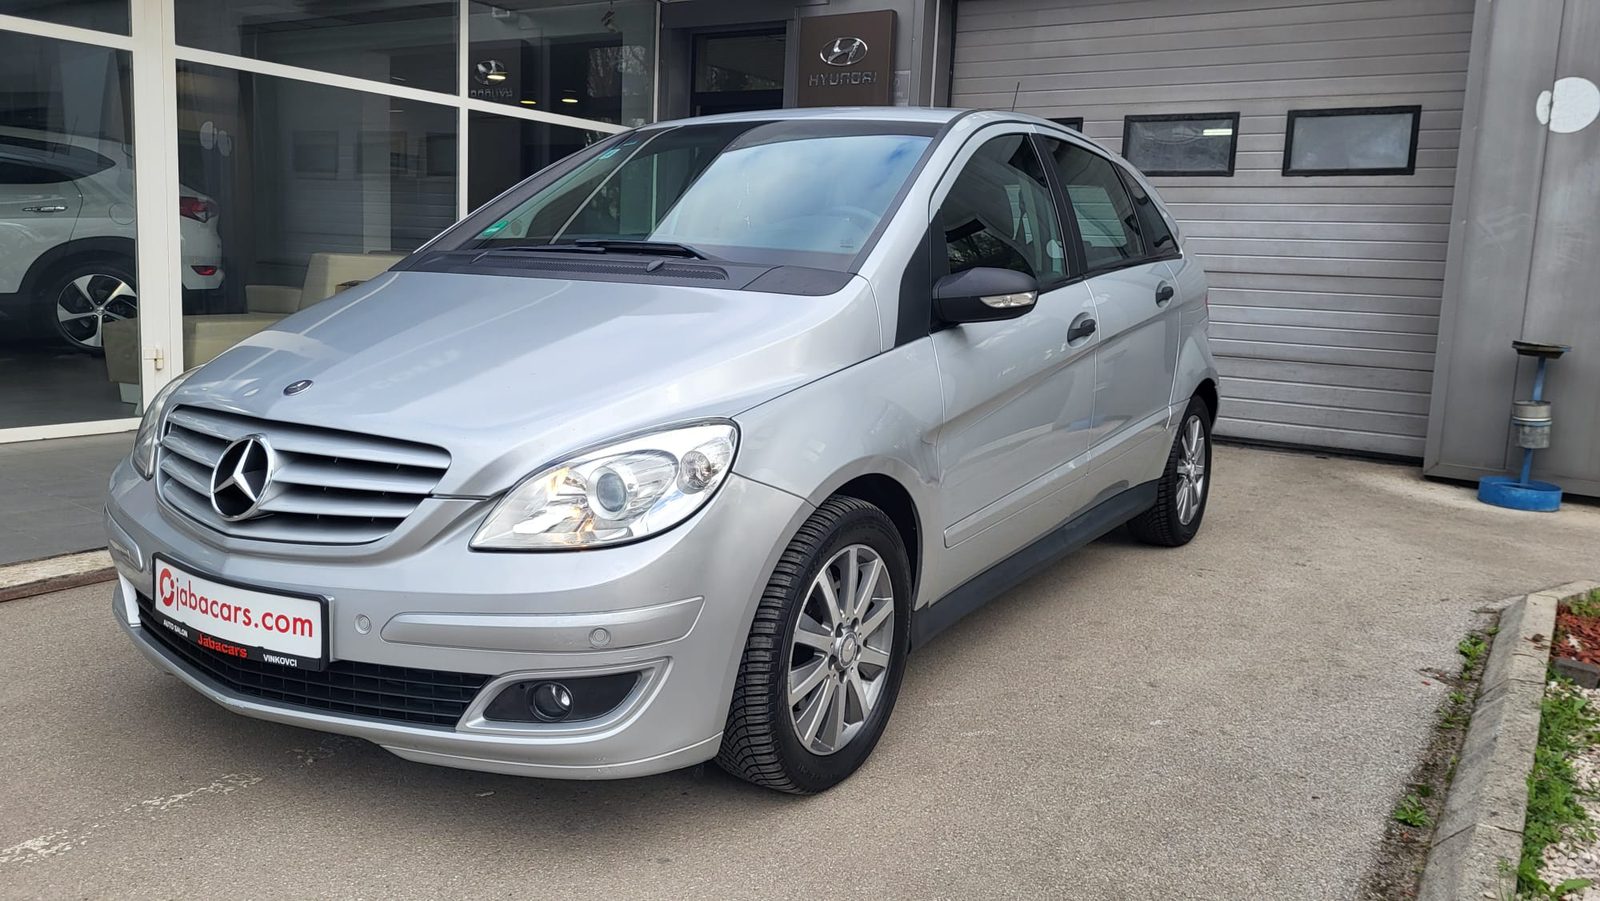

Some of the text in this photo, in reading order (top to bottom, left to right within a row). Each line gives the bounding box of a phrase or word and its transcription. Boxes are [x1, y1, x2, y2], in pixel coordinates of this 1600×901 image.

[808, 71, 877, 87] HYUNDAI
[176, 577, 313, 637] jabacars.com
[163, 619, 298, 667] AUTO SALON Jabacars VINKOVCI
